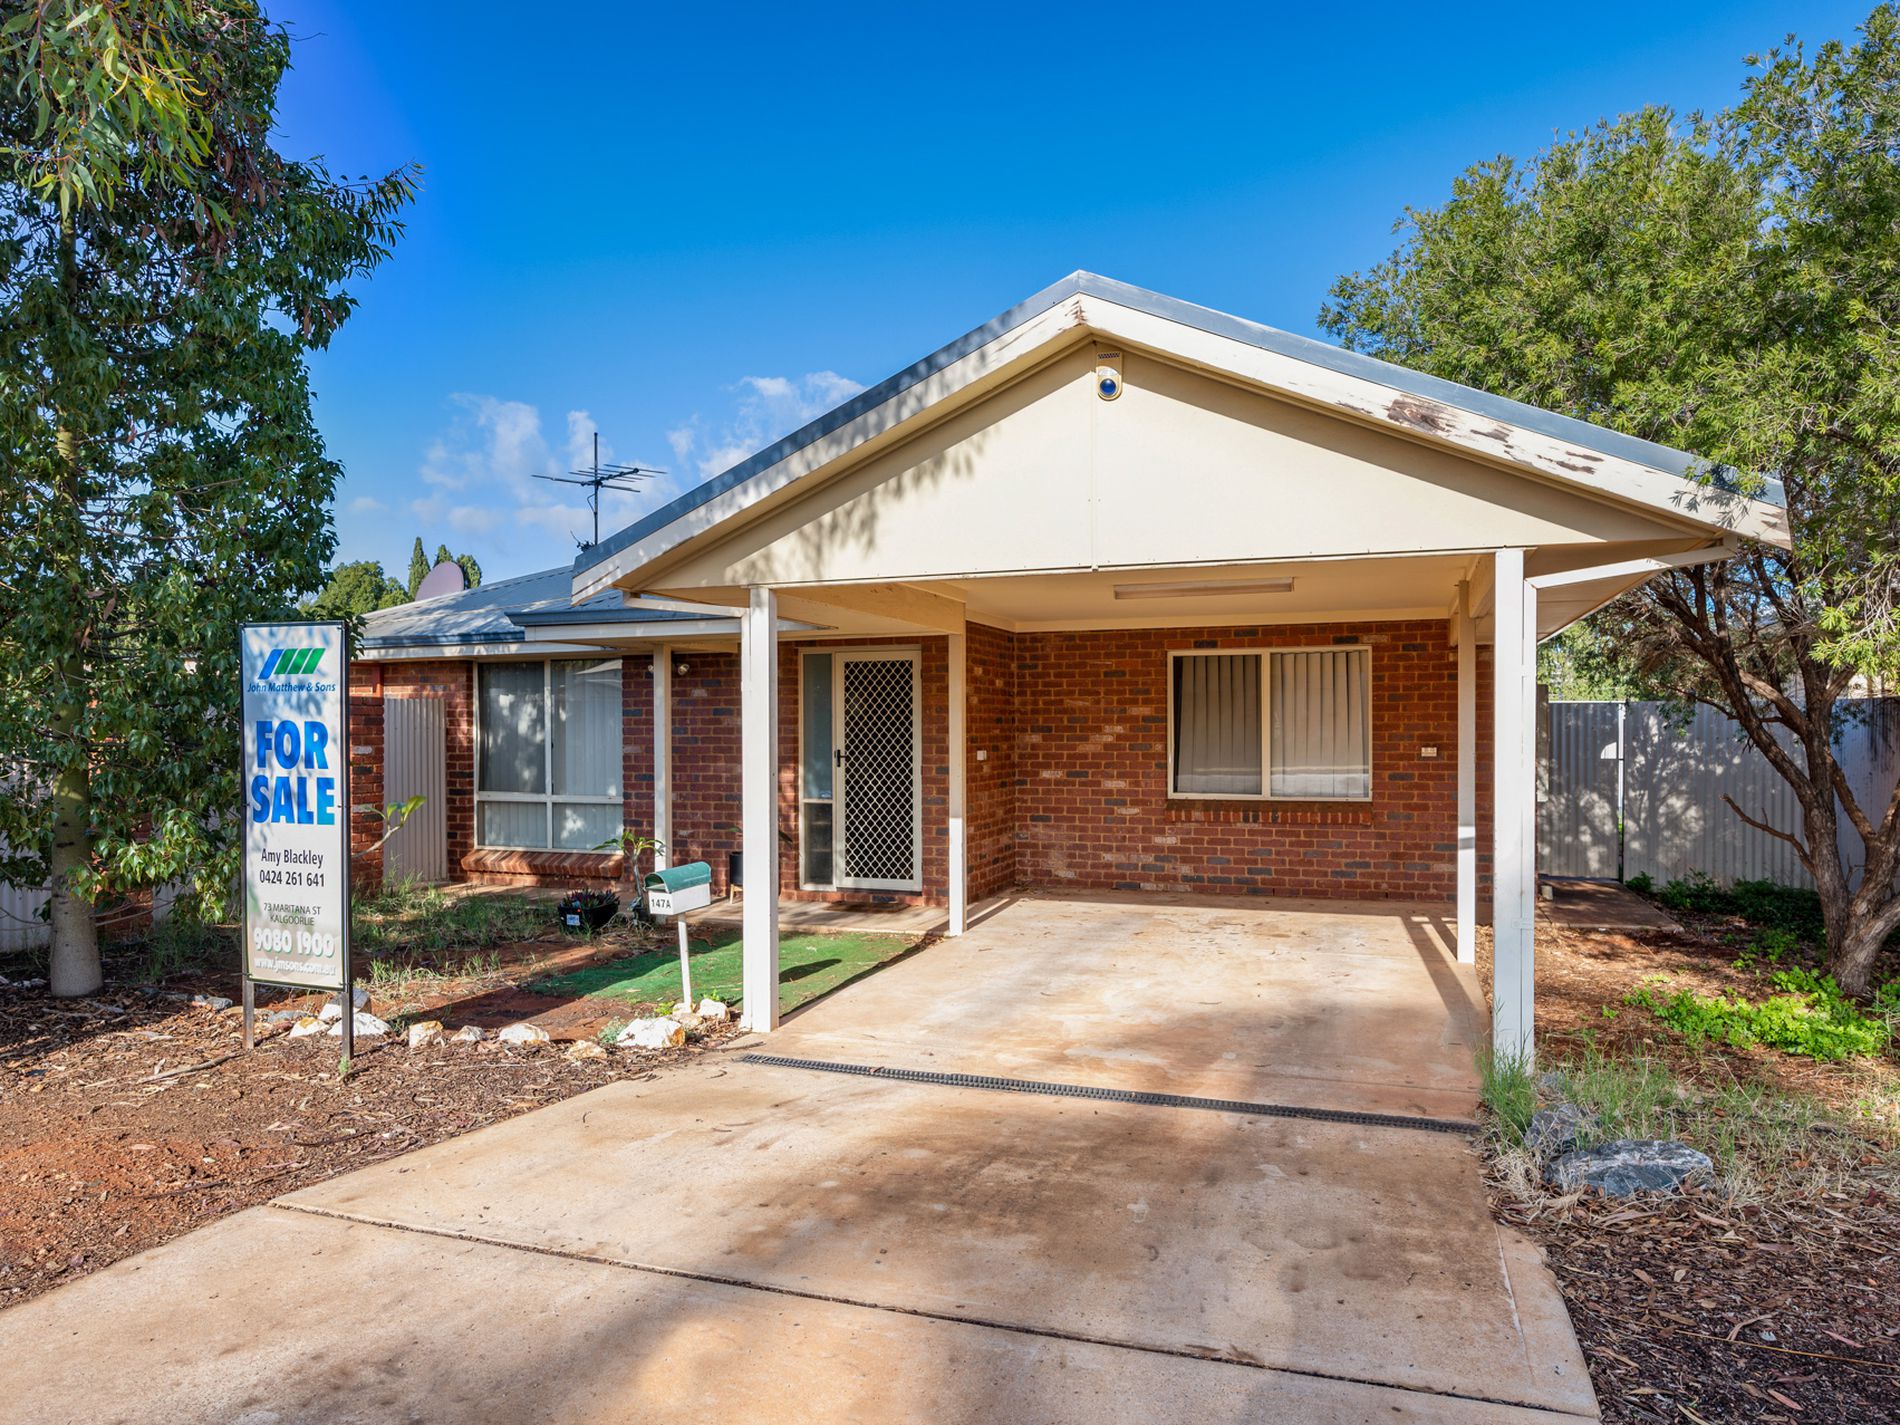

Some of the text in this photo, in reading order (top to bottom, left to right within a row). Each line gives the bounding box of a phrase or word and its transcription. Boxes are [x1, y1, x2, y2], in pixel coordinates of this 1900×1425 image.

[248, 682, 336, 692] John Matthew & Sons
[256, 720, 328, 769] FOR
[251, 775, 335, 825] SALE
[261, 848, 324, 869] Amy Blackley
[259, 869, 325, 887] 0424 261 641
[263, 902, 321, 916] 73 MARITANA ST
[651, 898, 671, 909] 147A
[270, 914, 315, 926] KALGOORLIE
[254, 927, 335, 958] 9080 1900
